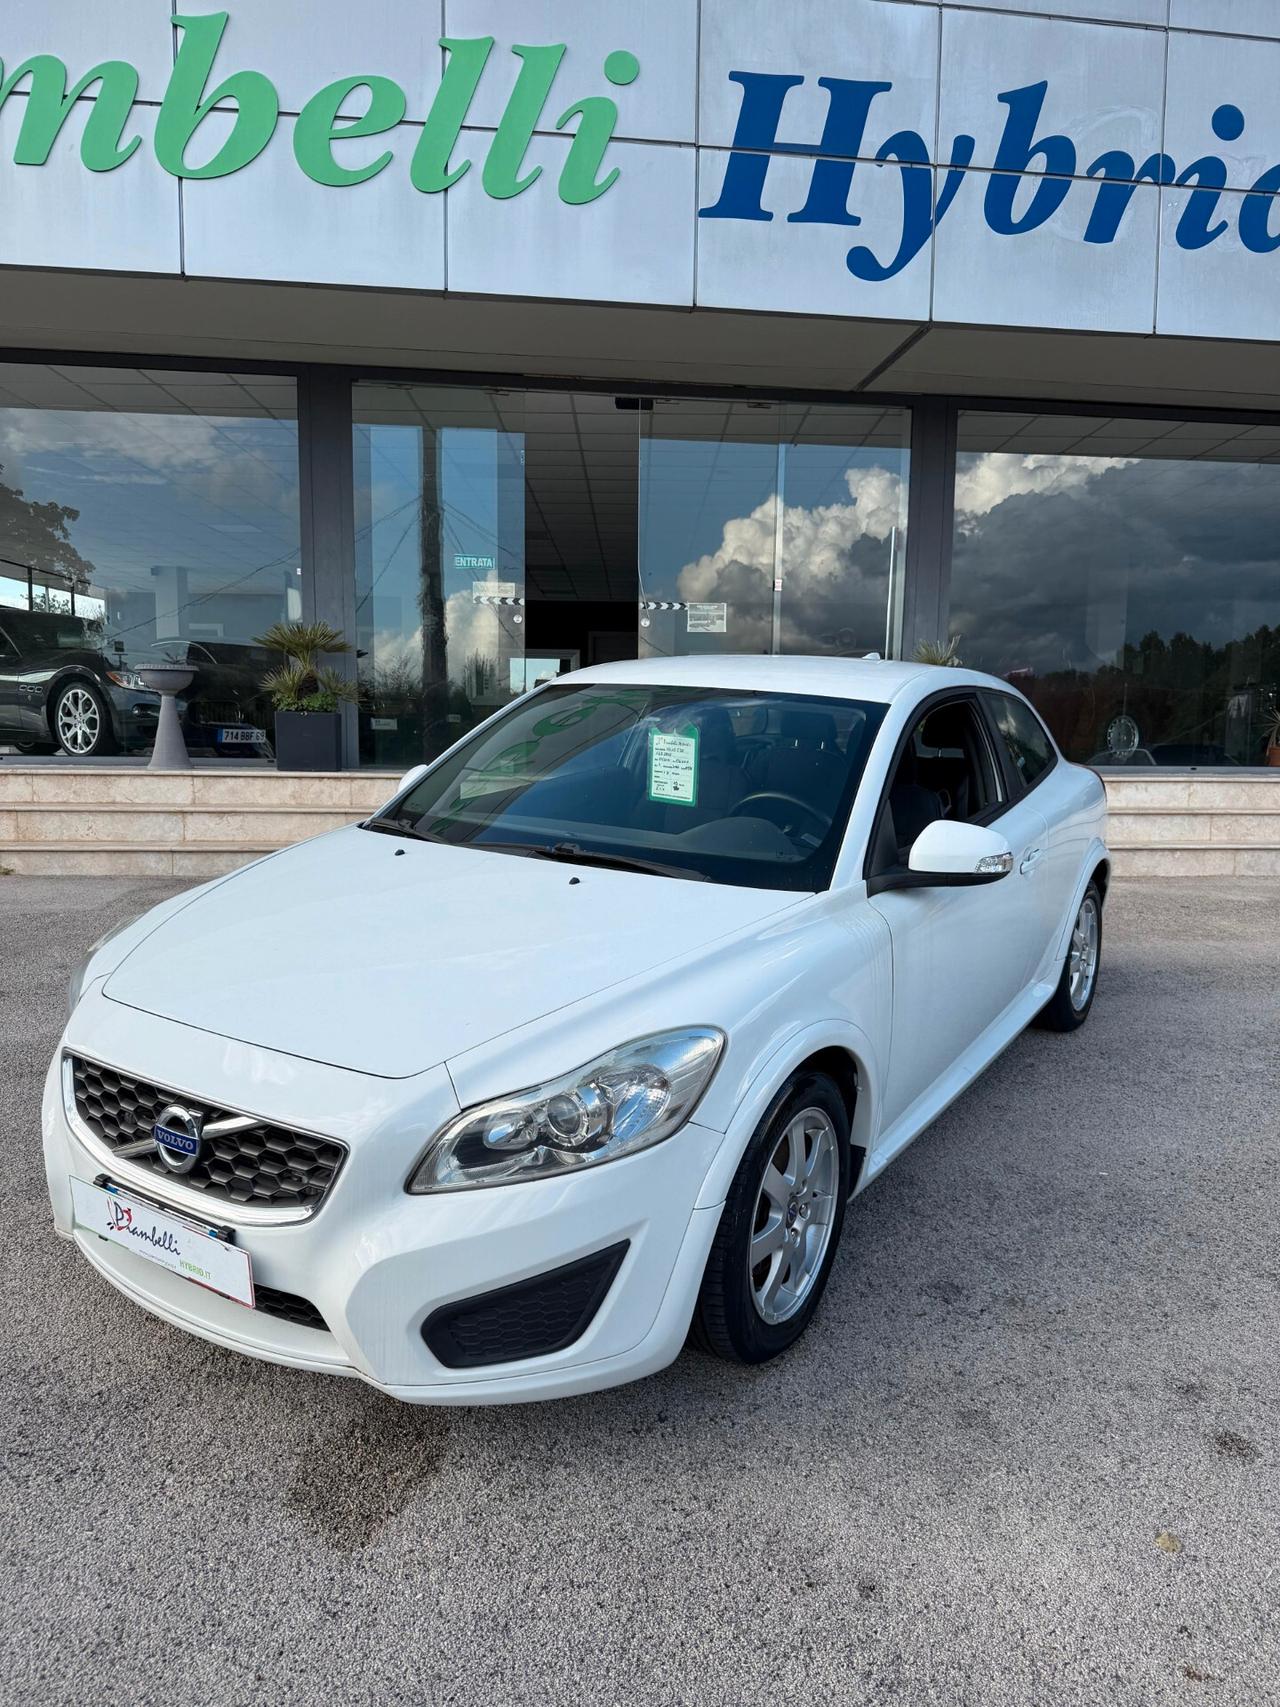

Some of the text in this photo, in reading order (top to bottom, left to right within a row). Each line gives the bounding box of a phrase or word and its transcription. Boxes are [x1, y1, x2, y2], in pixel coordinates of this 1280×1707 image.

[455, 556, 492, 568] ENTRATA
[224, 730, 239, 741] 714
[157, 1129, 194, 1150] VOLVO
